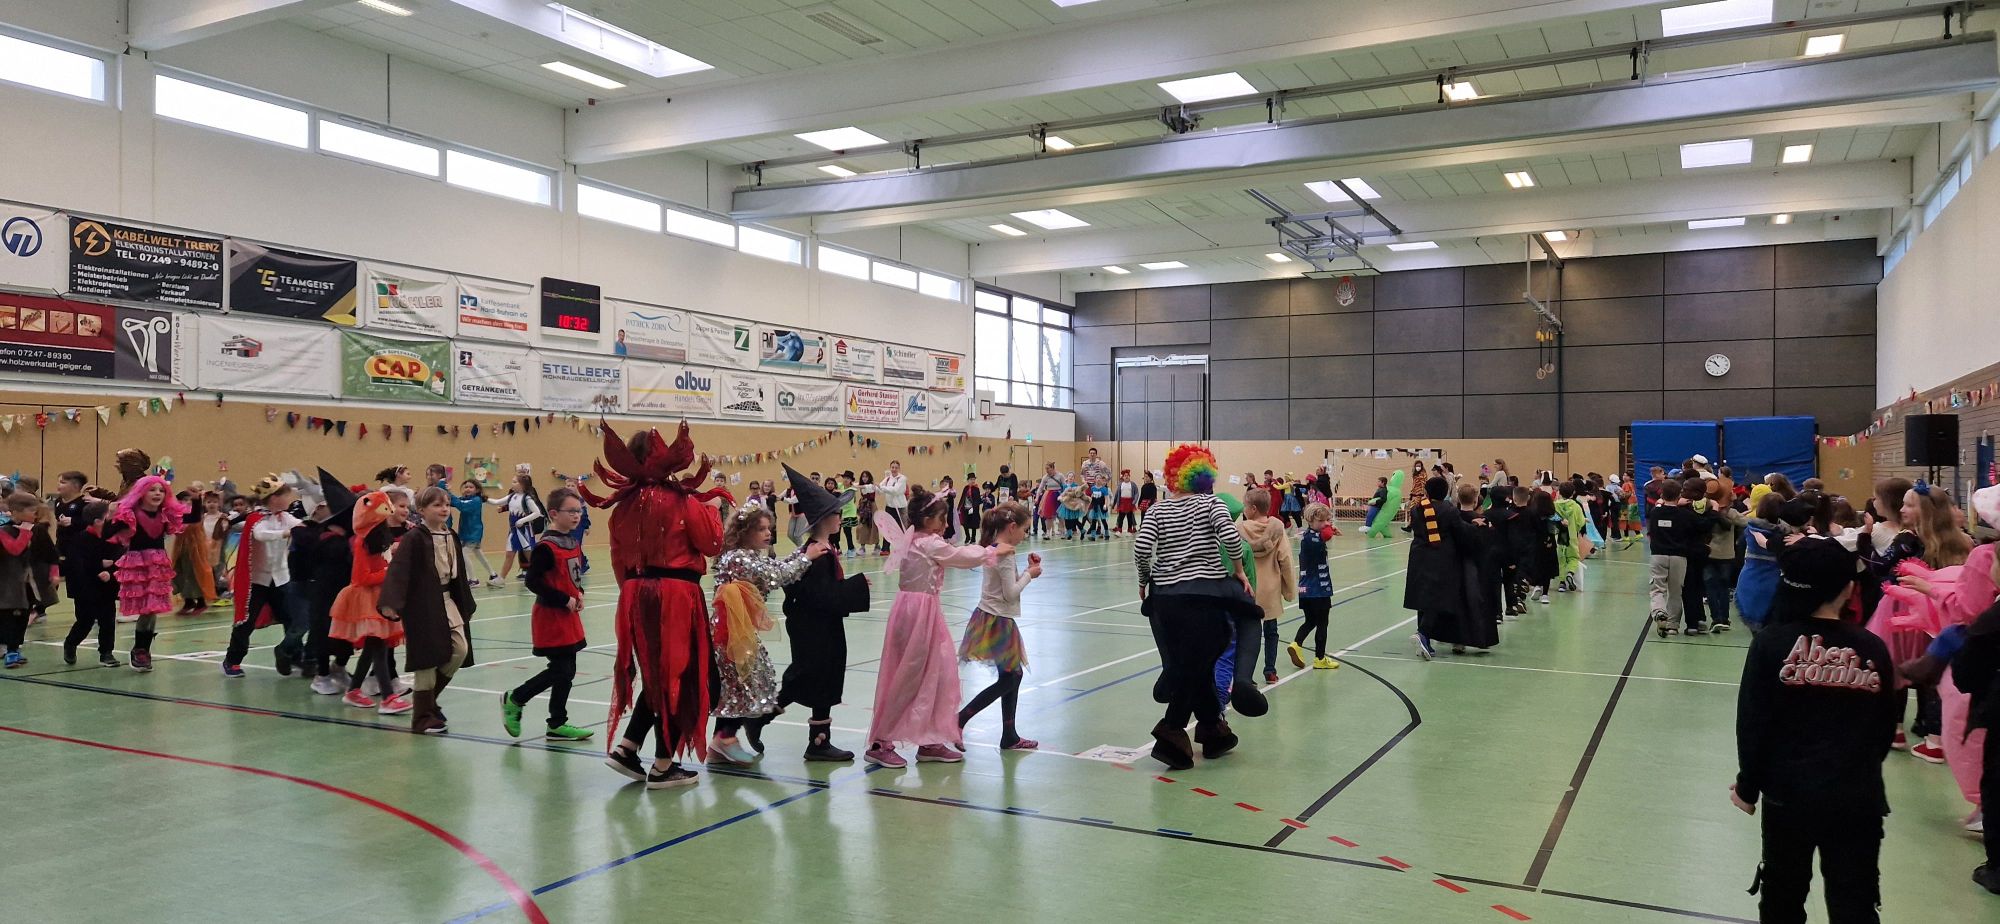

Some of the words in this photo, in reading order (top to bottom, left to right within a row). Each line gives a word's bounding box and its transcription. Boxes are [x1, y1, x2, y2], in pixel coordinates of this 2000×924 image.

[114, 229, 180, 248] KABELWELT
[184, 240, 220, 252] TRENZ
[116, 240, 216, 260] ELEKTROINSTALLATIONEN
[116, 250, 137, 260] TEL.
[140, 252, 172, 264] 07249
[180, 258, 218, 270] 94892-0
[78, 263, 149, 278] Elektroinstallationen
[78, 270, 128, 282] Meisterbetrieb
[78, 278, 129, 291] Elektroplanung
[162, 282, 189, 291] Beratung
[280, 275, 335, 290] TEAMGEIST
[78, 286, 112, 295] Notdienst
[291, 286, 325, 295] SPORTS
[160, 296, 220, 308] Komplettsanierung
[626, 319, 649, 328] PATRICK
[652, 322, 666, 331] ZORN
[893, 350, 916, 359] Schindler
[374, 358, 421, 378] CAP
[543, 363, 620, 378] STELLBERG
[675, 371, 711, 391] albw
[858, 390, 878, 398] Gerhard
[1779, 659, 1881, 693] crombie
